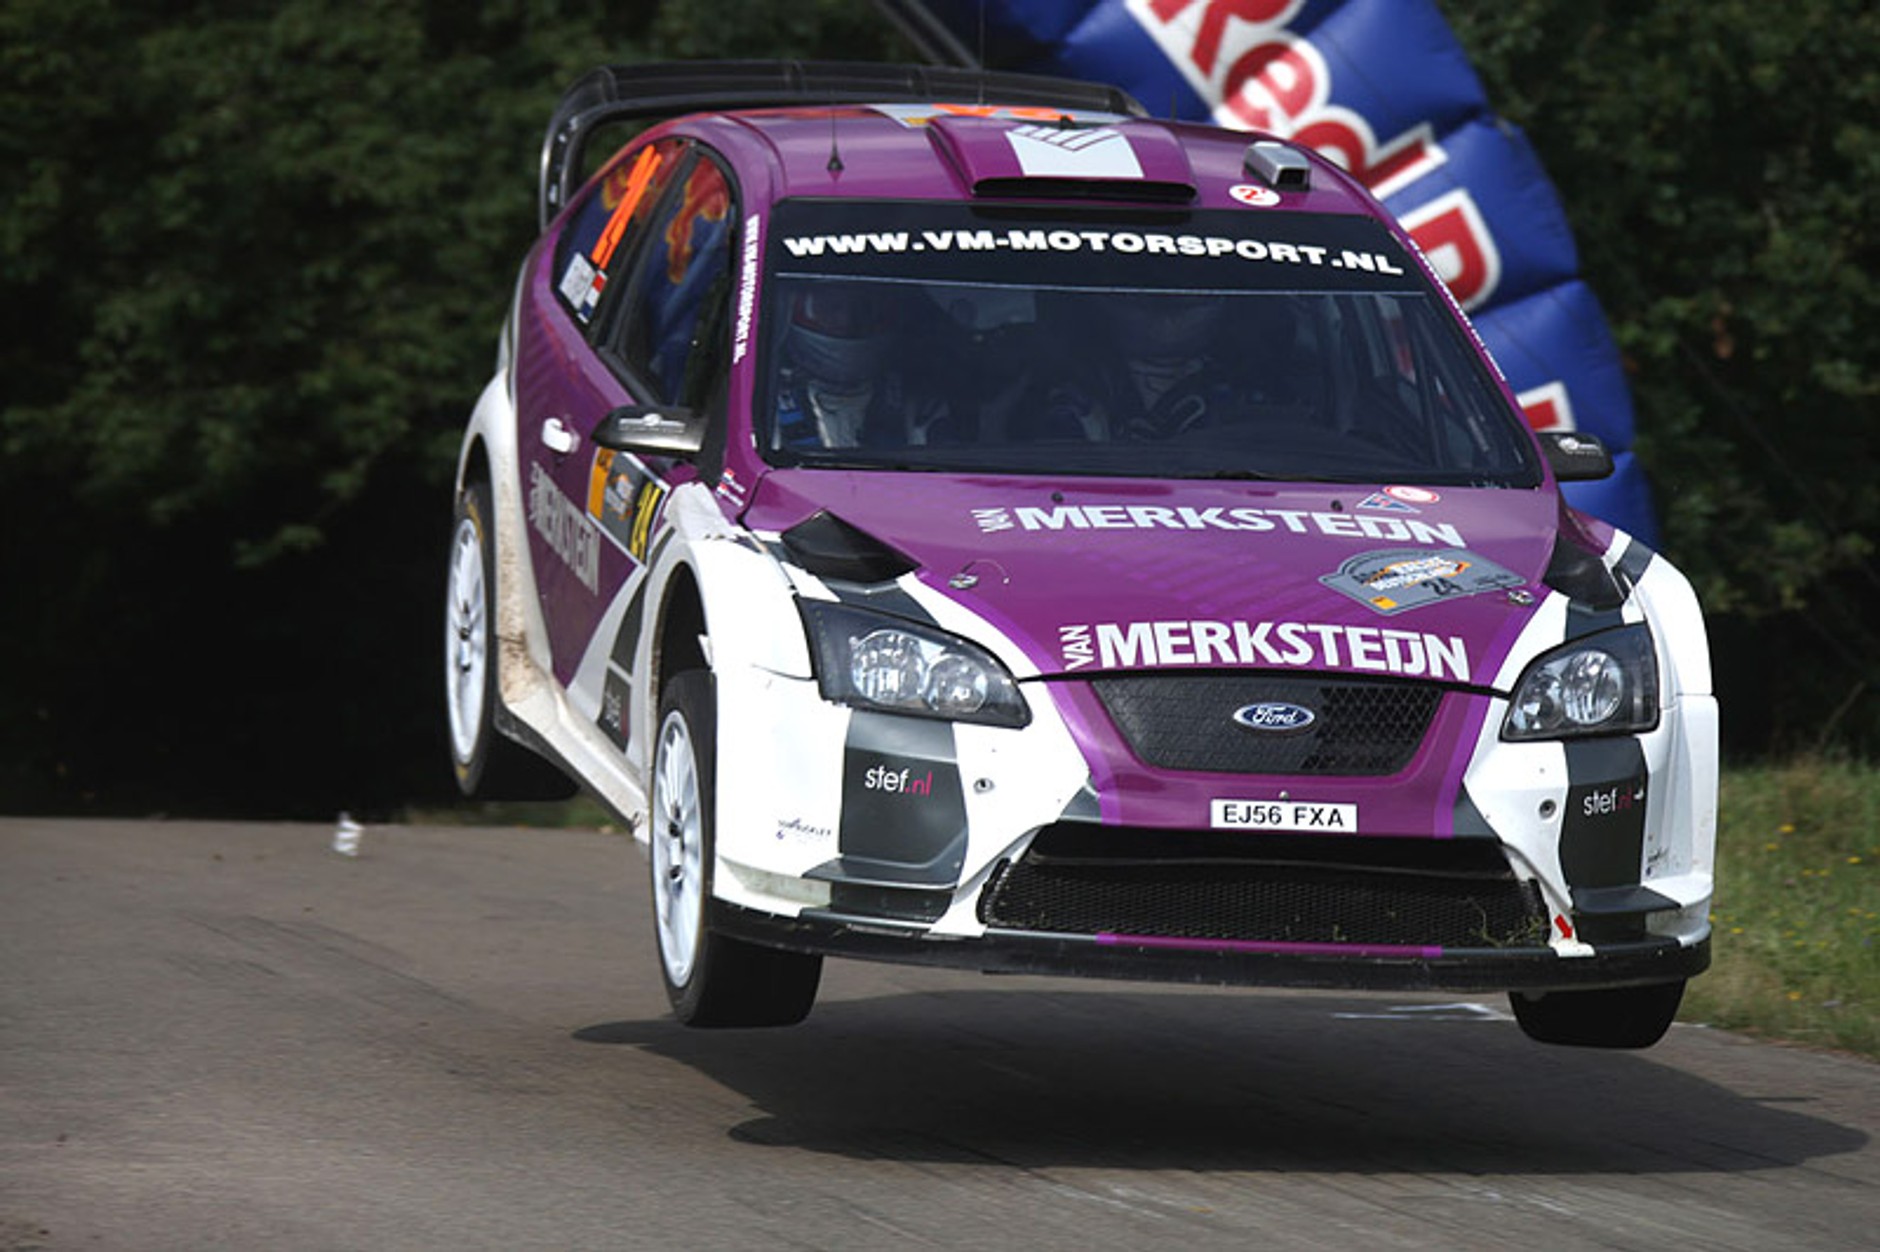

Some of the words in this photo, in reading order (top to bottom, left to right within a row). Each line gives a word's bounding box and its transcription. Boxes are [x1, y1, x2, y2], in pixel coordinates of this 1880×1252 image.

[783, 229, 1404, 275] WWW.VM-MOTORSPORT.NL
[1014, 506, 1466, 548] MERKSTEIJN
[1059, 625, 1093, 670] VAN
[1095, 621, 1470, 682] MERKSTEIJN
[1253, 706, 1299, 723] Ford
[864, 765, 933, 796] stef.nl
[1223, 804, 1282, 825] EJ56
[1294, 806, 1344, 827] FXA
